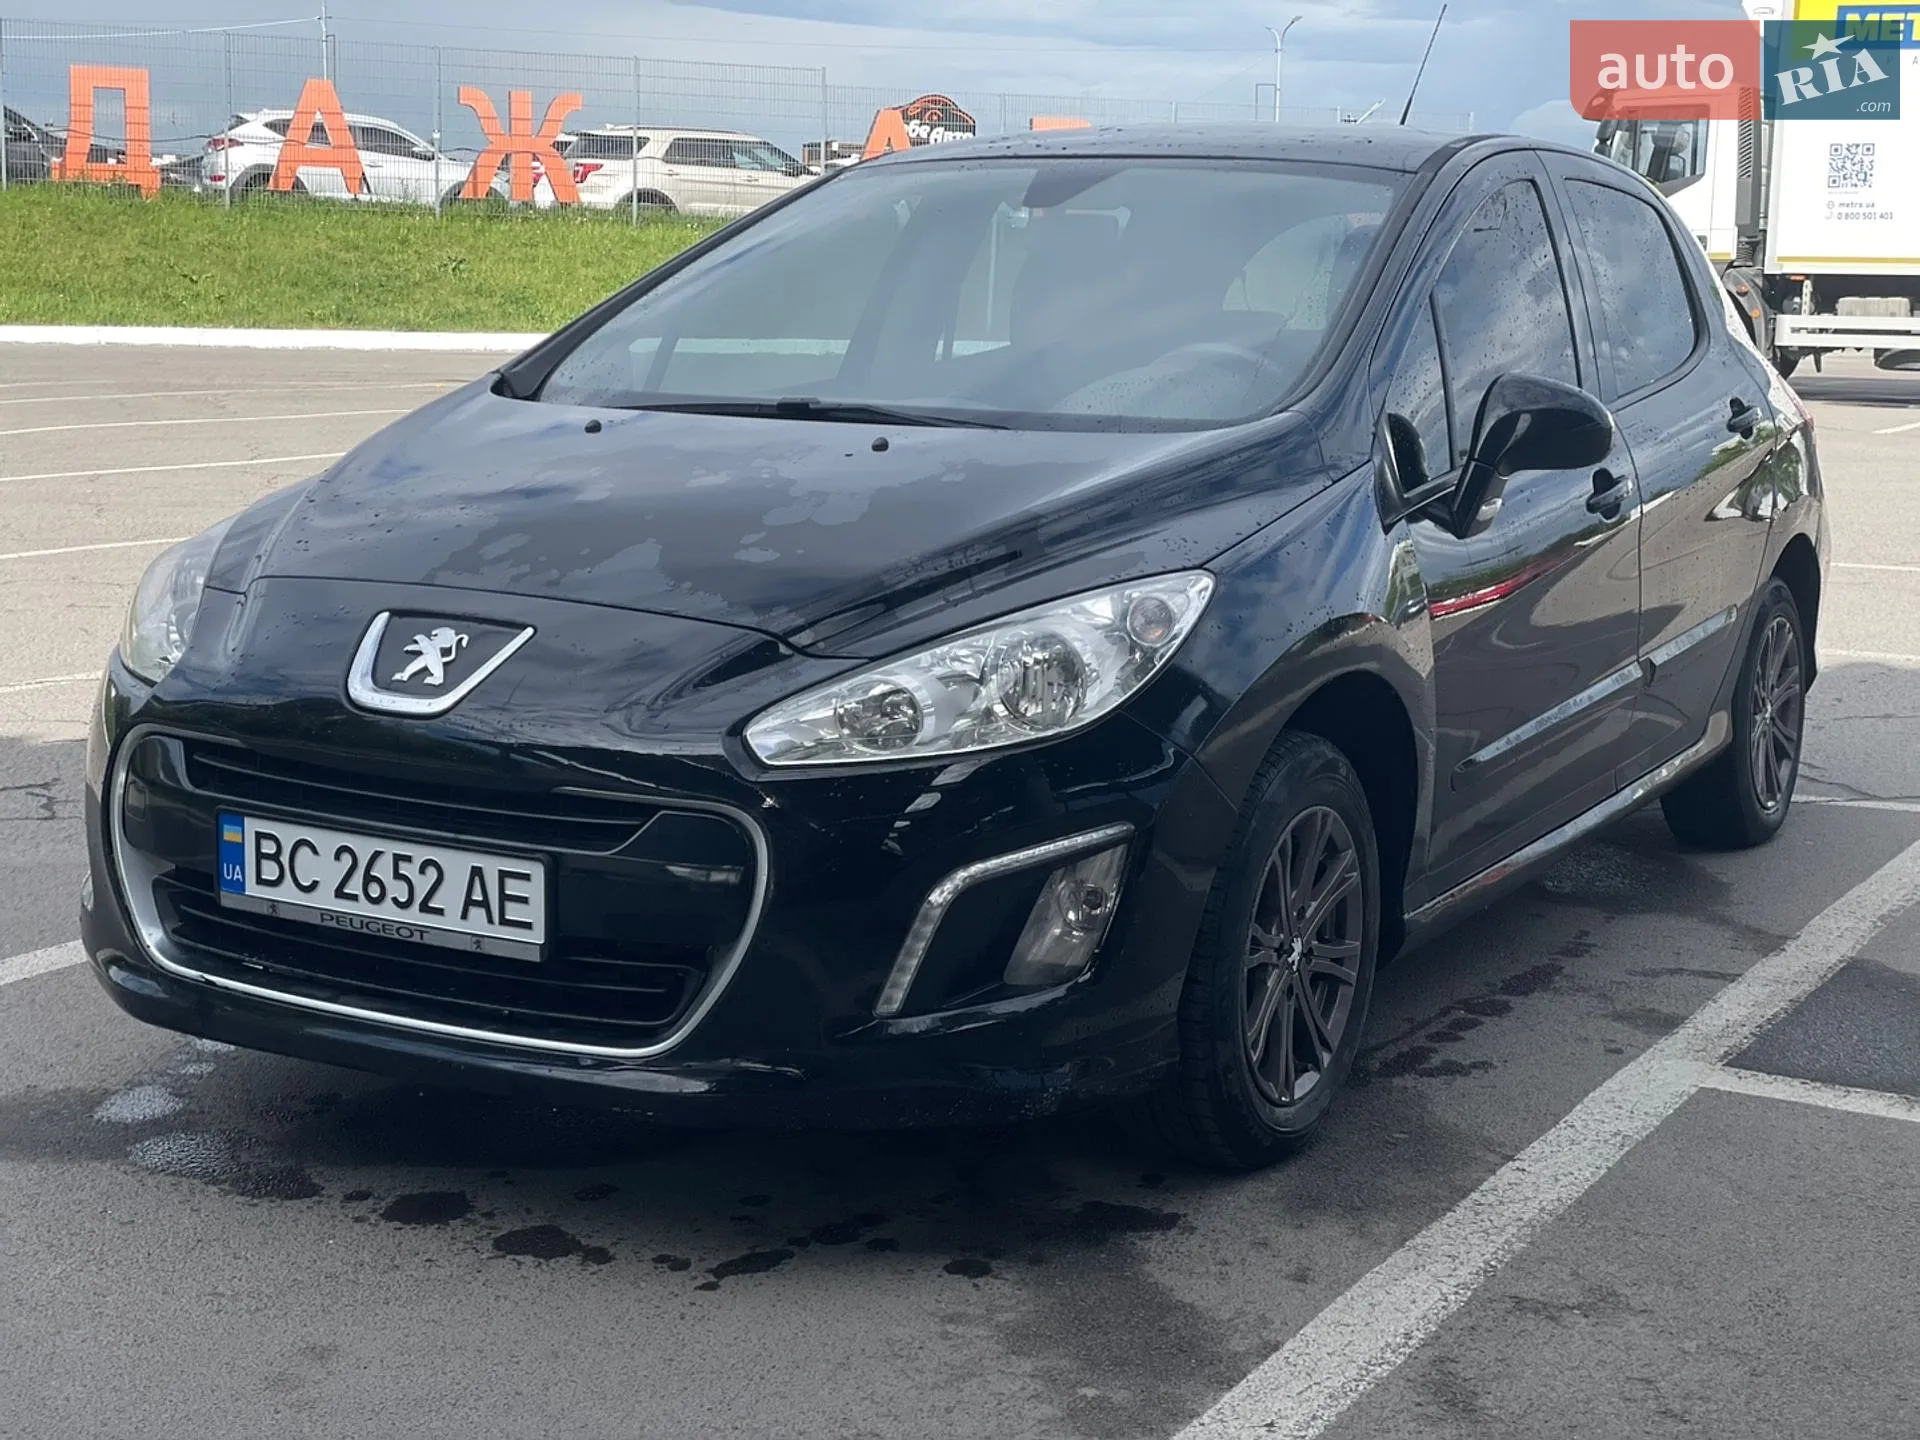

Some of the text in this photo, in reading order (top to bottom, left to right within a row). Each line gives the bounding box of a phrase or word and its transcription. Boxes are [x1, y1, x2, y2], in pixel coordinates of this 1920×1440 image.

[223, 863, 243, 882] UA
[254, 830, 533, 930] BC 2652 AE
[319, 912, 431, 941] PEUGEOT
